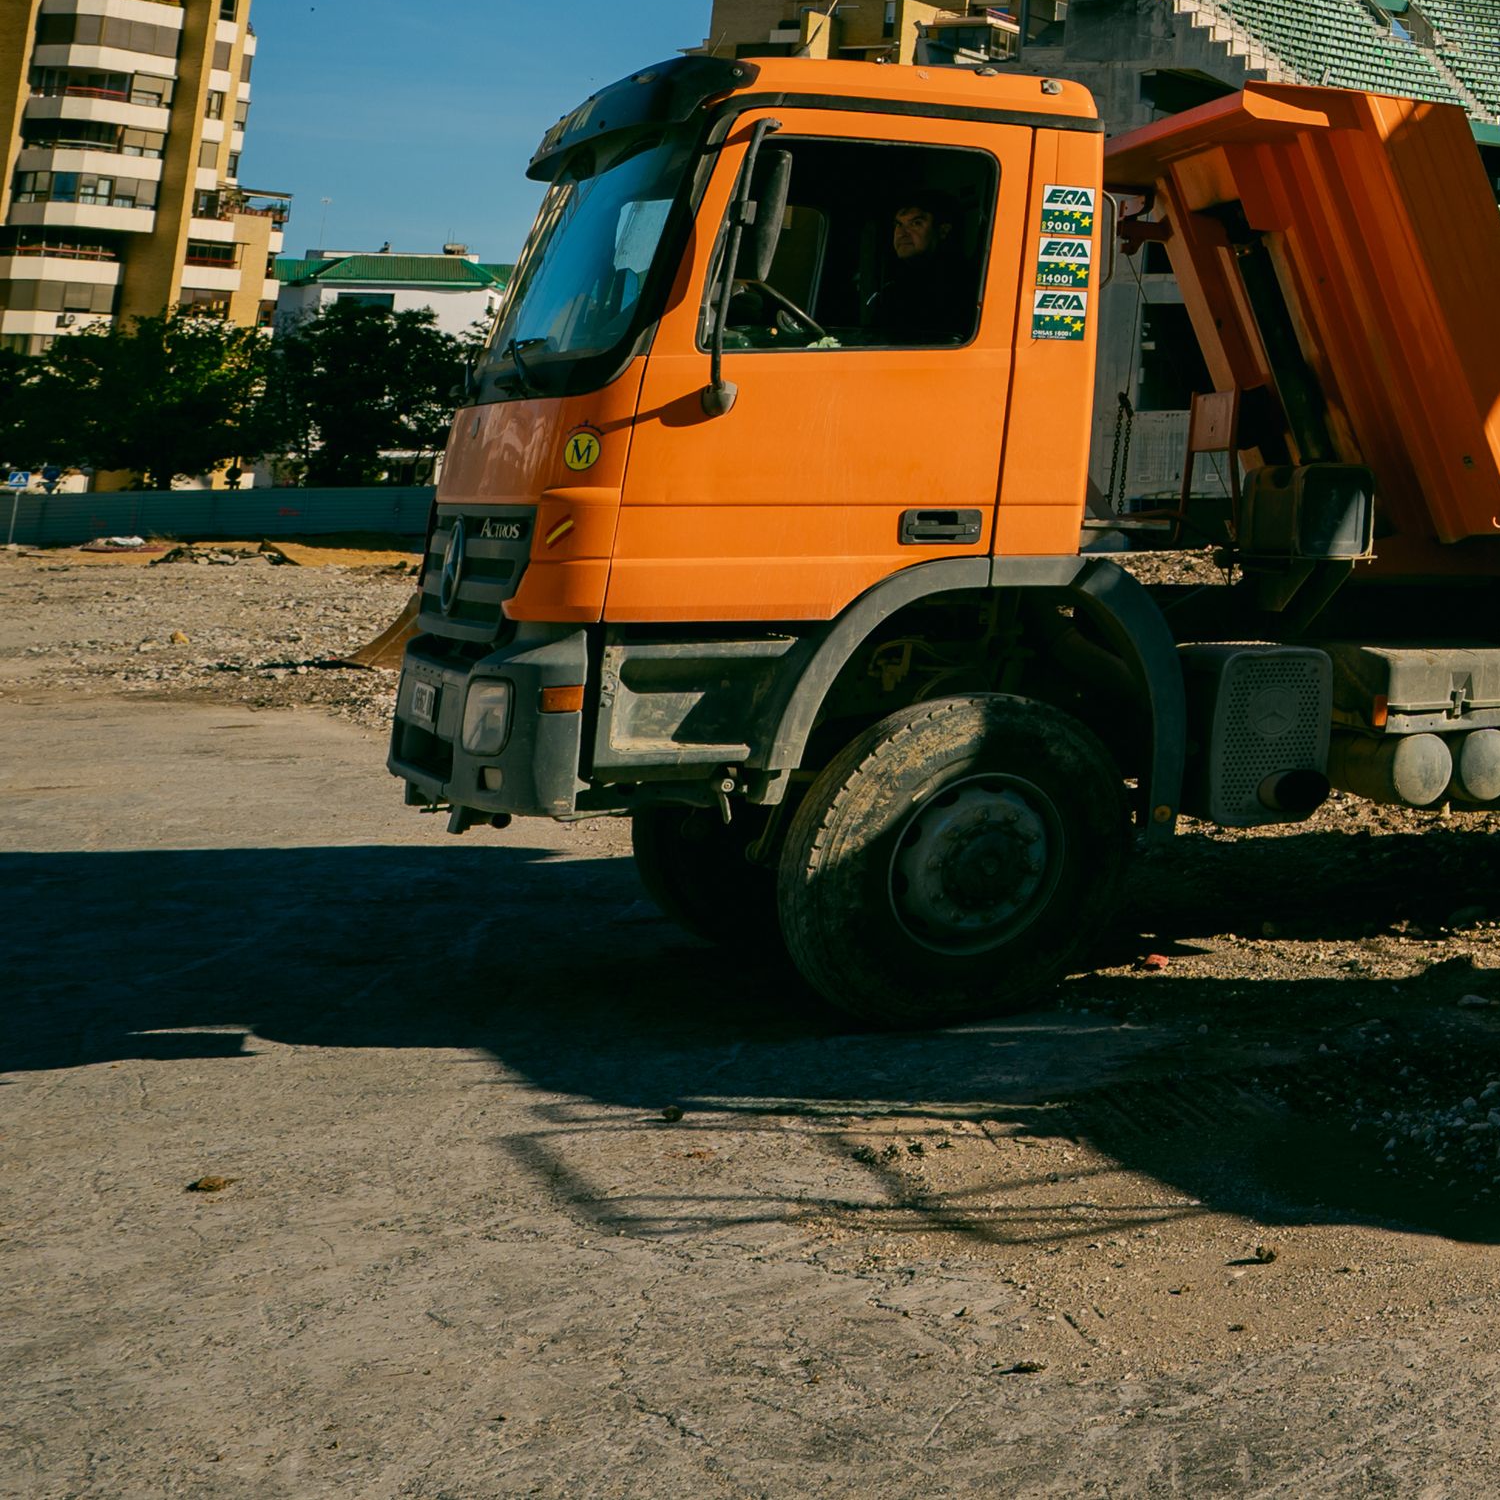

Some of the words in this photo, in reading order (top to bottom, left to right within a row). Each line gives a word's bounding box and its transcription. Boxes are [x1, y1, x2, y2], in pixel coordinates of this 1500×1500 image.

[1045, 189, 1092, 206] EQA
[1047, 221, 1076, 232] 9001
[1040, 241, 1089, 258] EQA
[1042, 274, 1073, 284] 14001
[1035, 294, 1084, 310] EQA
